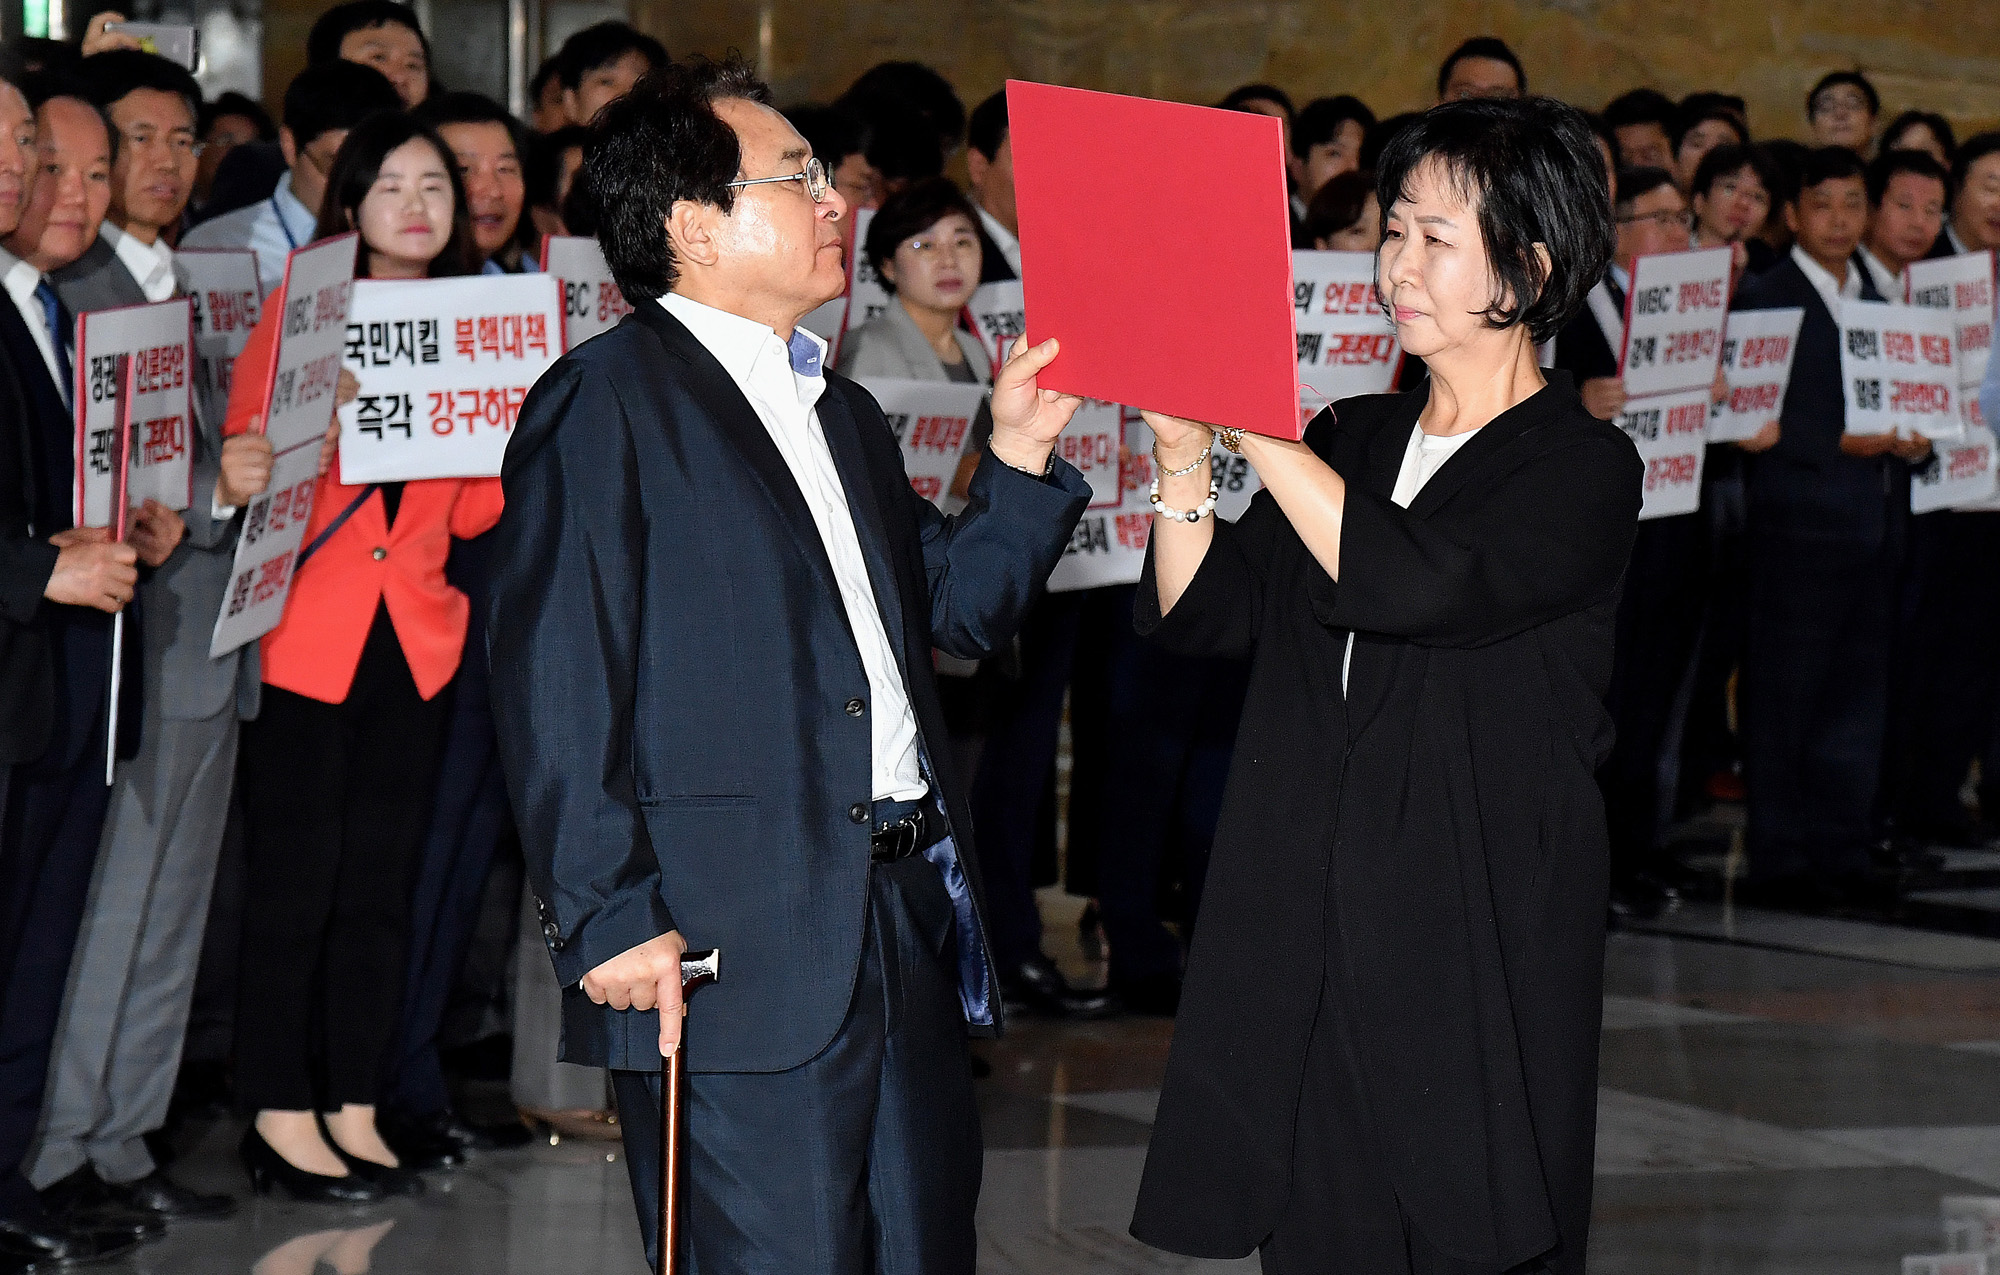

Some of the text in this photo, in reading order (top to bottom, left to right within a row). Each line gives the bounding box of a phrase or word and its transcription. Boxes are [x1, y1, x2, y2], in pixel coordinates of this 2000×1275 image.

[566, 281, 590, 316] BC
[1324, 282, 1381, 314] 언론탄
[1638, 286, 1671, 314] MBC
[345, 314, 548, 368] 국민지킬 북핵대책
[1297, 334, 1395, 365] 께 규탄한다
[92, 354, 129, 402] 정권
[137, 345, 184, 394] 언론탄압
[357, 393, 413, 441] 즉각
[911, 416, 968, 452] 북핵대책
[144, 415, 185, 465] 규탄한다
[1212, 454, 1248, 492] 엄중
